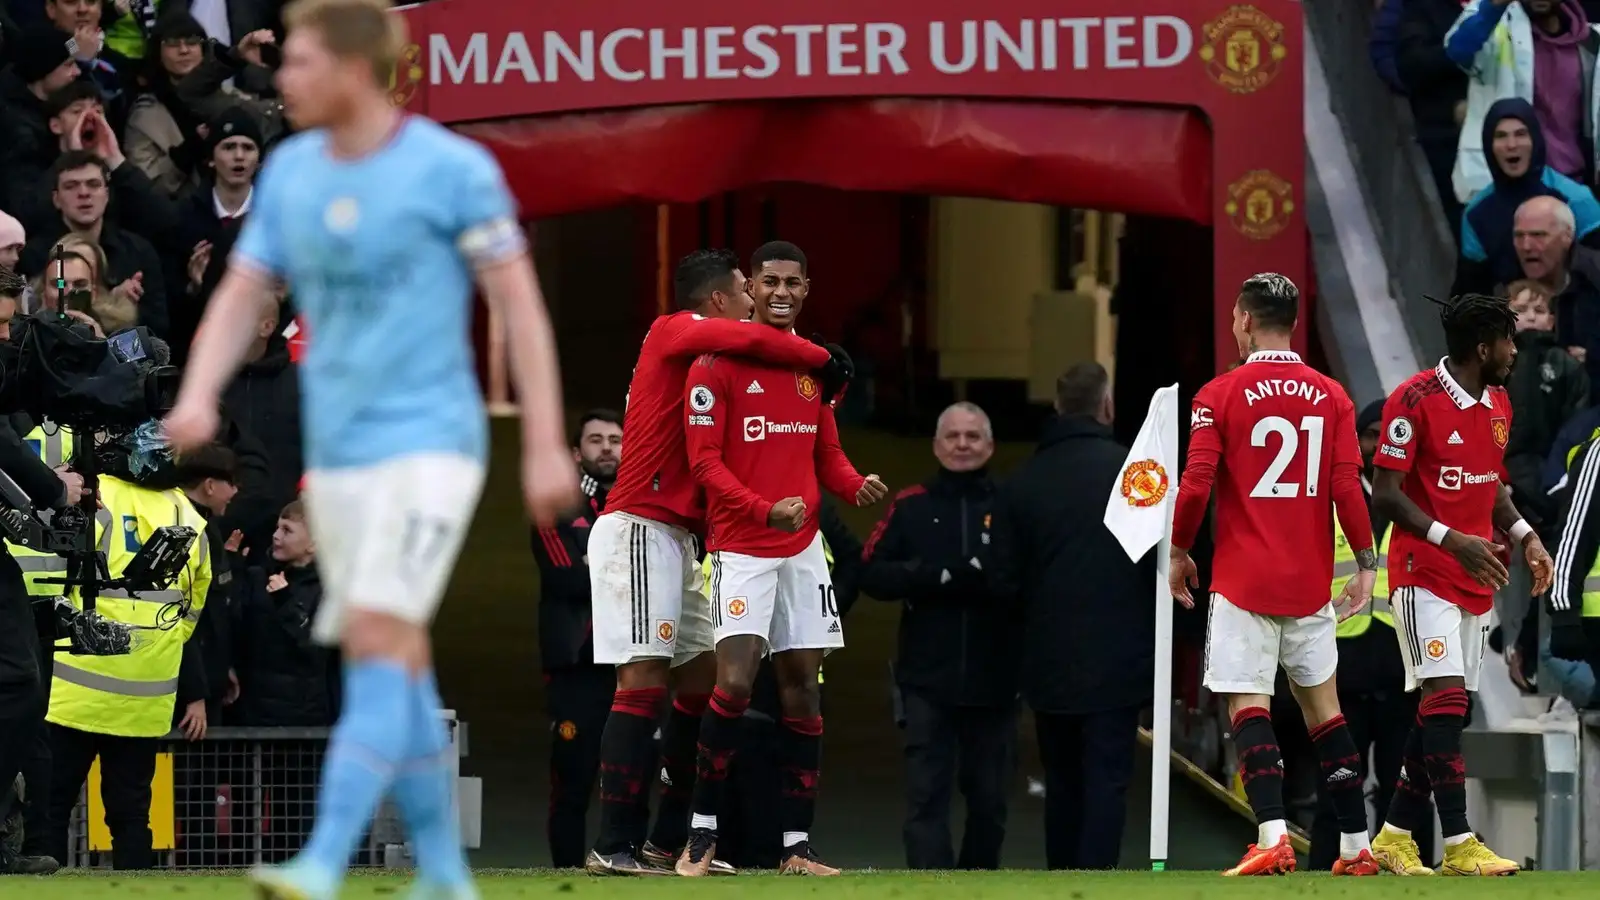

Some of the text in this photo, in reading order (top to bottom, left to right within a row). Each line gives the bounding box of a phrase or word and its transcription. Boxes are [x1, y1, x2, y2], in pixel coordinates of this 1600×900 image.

[429, 22, 910, 85] MANCHESTER
[929, 15, 1193, 74] UNITED
[1244, 379, 1328, 406] ANTONY
[765, 421, 818, 434] TeamViewe
[1249, 415, 1325, 498] 21
[818, 583, 839, 618] 10
